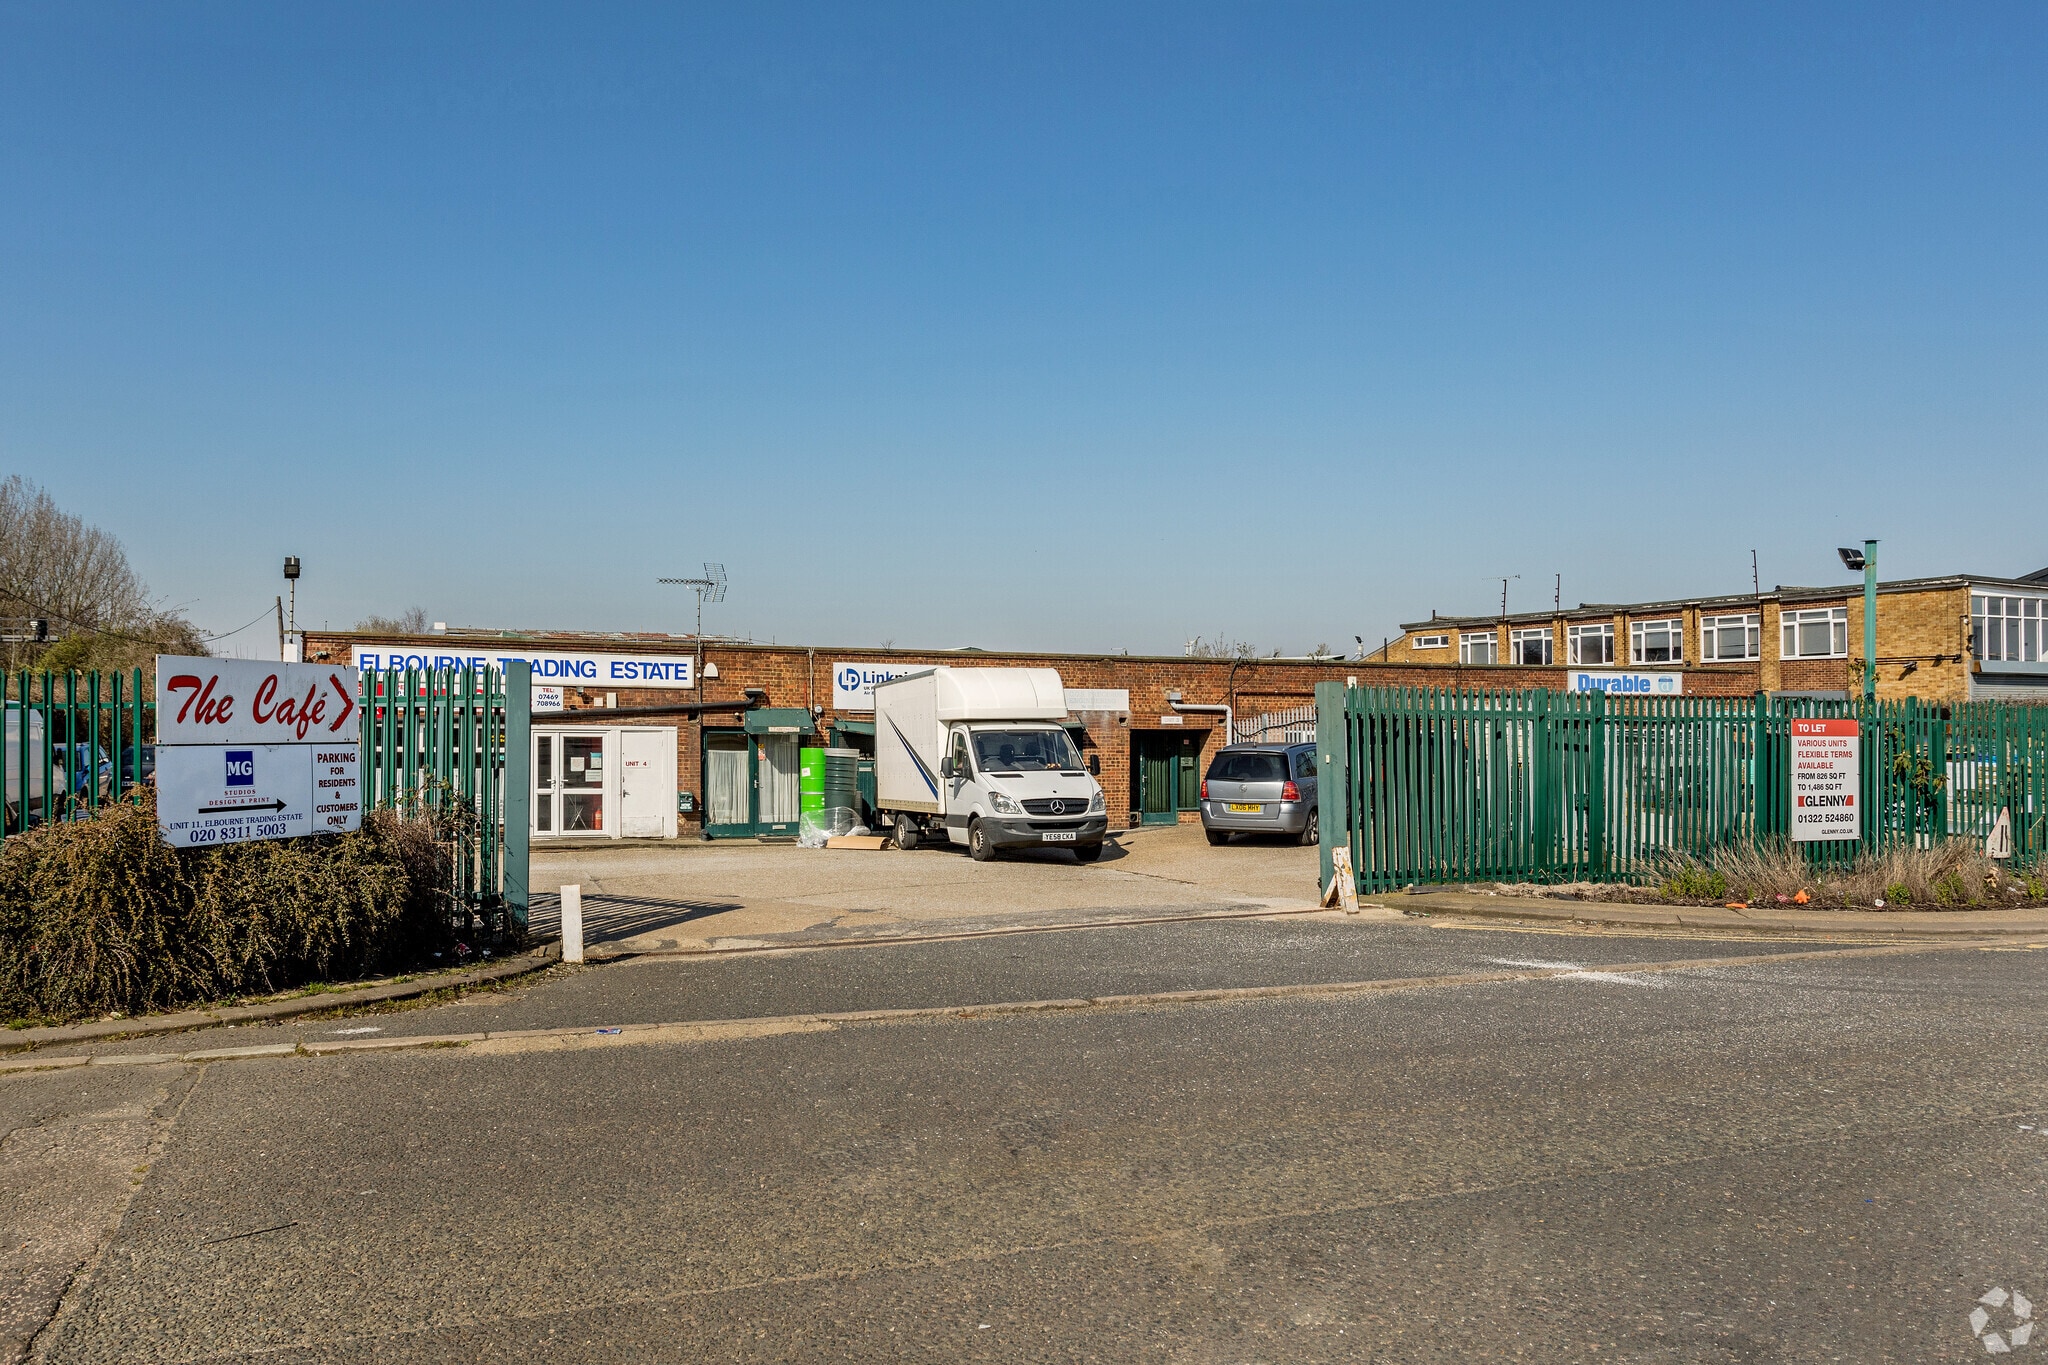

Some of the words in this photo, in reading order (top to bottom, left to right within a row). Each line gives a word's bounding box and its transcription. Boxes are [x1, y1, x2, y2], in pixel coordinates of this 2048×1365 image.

[497, 657, 597, 678] TADING
[611, 661, 688, 681] ESTATE
[1577, 674, 1651, 692] Durable
[167, 675, 234, 725] The
[253, 674, 328, 740] Café
[1798, 724, 1809, 733] TO
[1811, 724, 1826, 733] LET
[317, 753, 356, 763] PARKING
[227, 761, 253, 776] MG
[330, 767, 345, 775] FOR
[318, 778, 356, 788] RESIDENTS
[335, 791, 341, 799] &
[1805, 795, 1847, 807] GLENNY
[316, 803, 358, 813] CUSTOMERS
[170, 821, 189, 830] UNIT
[205, 817, 244, 828] ELBOURNE
[246, 815, 277, 824] TRADING
[278, 813, 303, 821] ESTATE
[327, 815, 348, 825] ONLY
[1798, 814, 1823, 823] 01322
[1825, 813, 1854, 823] 524860
[190, 829, 216, 842] 020
[220, 826, 251, 841] 8311
[256, 823, 287, 837] 5003
